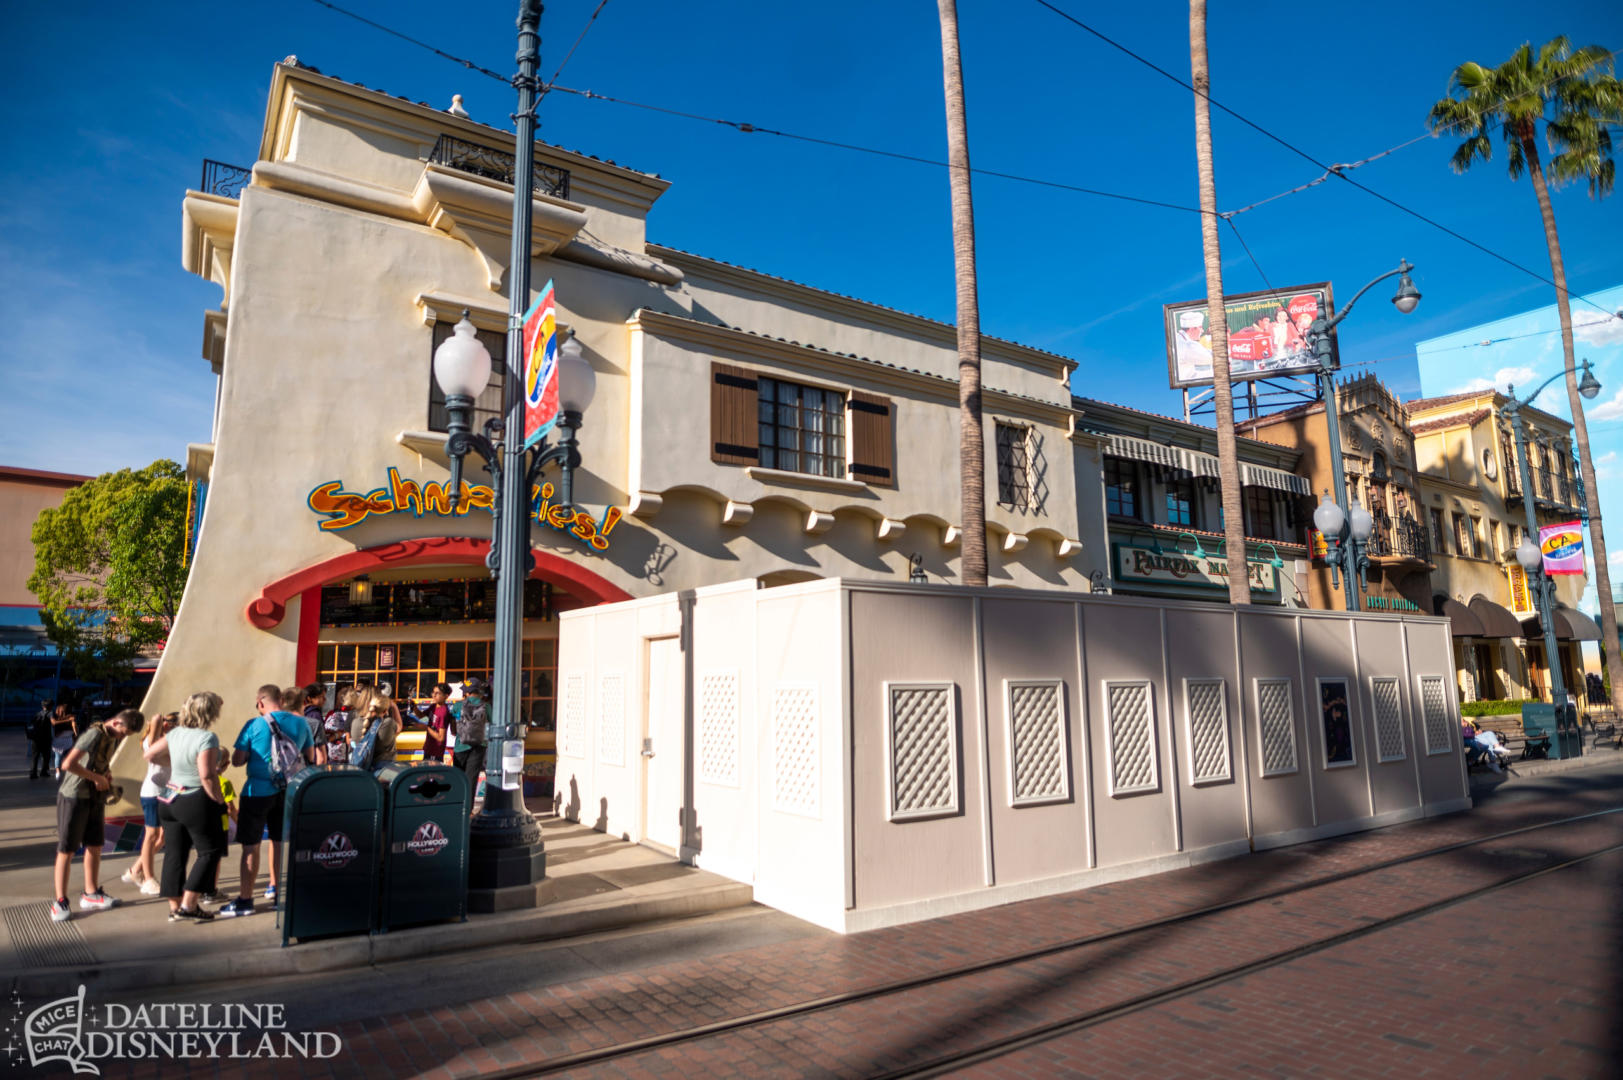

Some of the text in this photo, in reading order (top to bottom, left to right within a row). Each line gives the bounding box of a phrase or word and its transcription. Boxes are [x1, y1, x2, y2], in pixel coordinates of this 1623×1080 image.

[307, 467, 623, 551] Schmoies!
[1207, 561, 1264, 584] MAET
[407, 838, 449, 849] HOLLYWOOD
[313, 850, 358, 860] HOLLYWOOD
